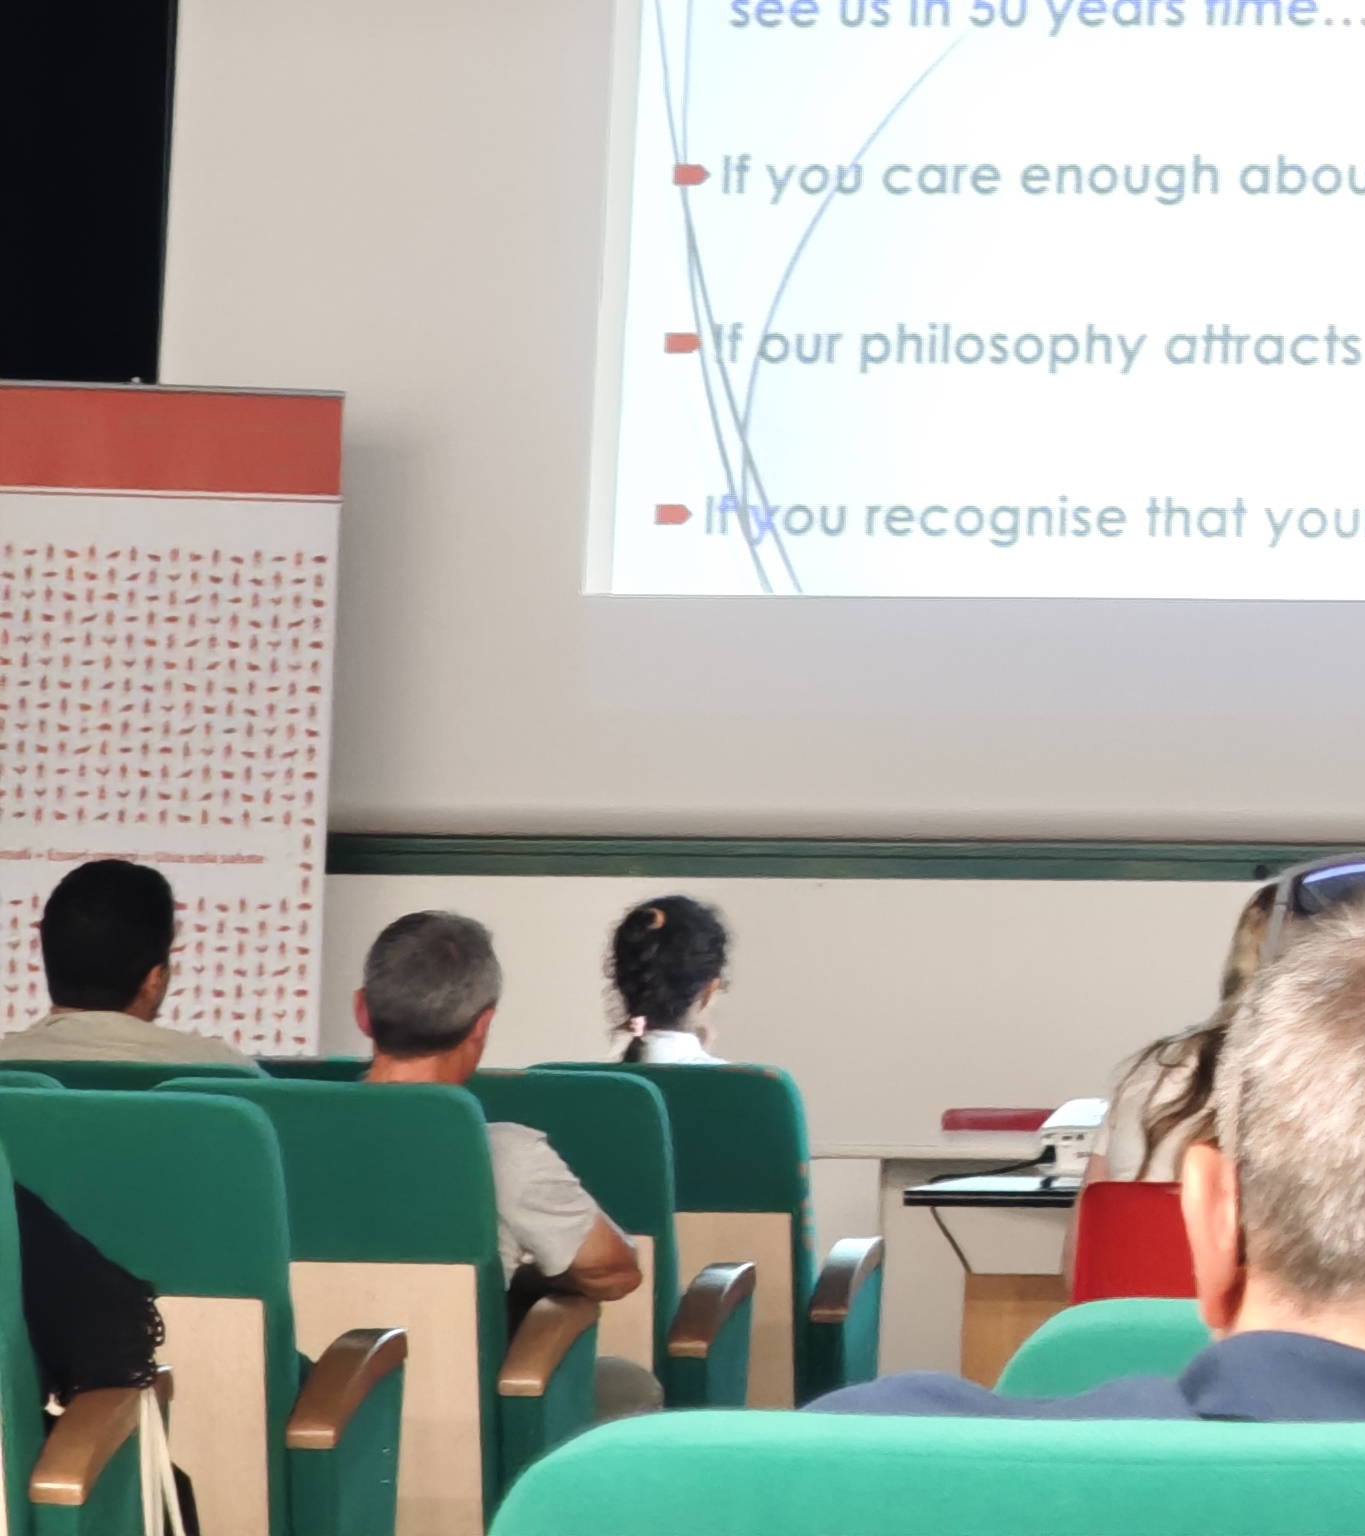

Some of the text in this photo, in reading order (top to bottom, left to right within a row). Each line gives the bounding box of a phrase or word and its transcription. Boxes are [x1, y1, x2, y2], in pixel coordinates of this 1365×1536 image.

[722, 153, 752, 194] If
[766, 163, 863, 205] you
[882, 163, 1002, 195] care
[1020, 154, 1219, 206] enough
[714, 323, 744, 364] If
[759, 331, 843, 364] our
[860, 322, 1147, 375] philosophy
[1165, 324, 1362, 365] attracts
[706, 495, 738, 536] If
[748, 504, 846, 546] you
[866, 495, 1127, 548] recognise
[1146, 496, 1247, 538] that
